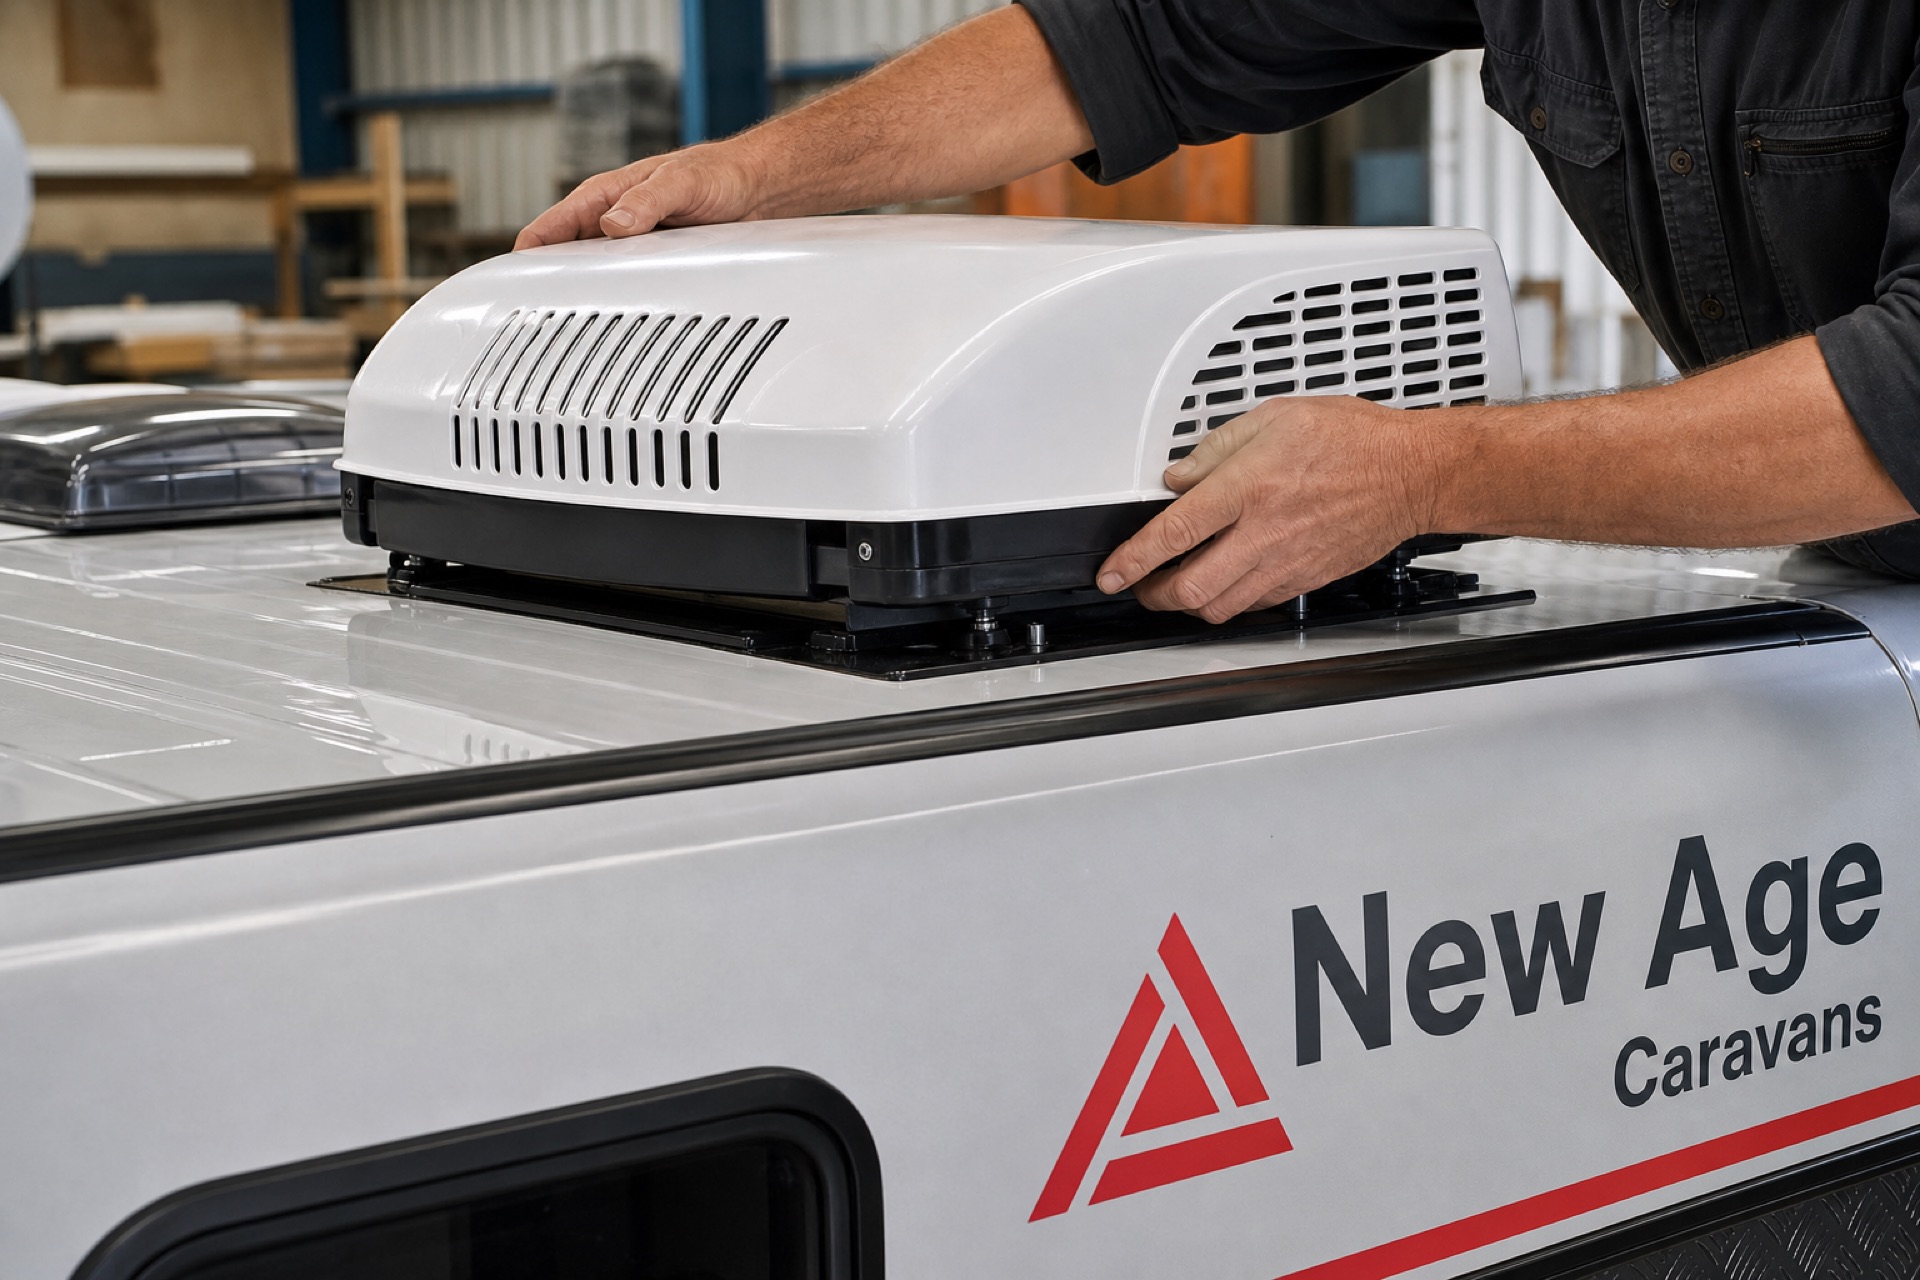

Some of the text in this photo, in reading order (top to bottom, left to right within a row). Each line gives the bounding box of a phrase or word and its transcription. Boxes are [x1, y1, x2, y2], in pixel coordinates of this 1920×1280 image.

[1291, 834, 1883, 1067] New Age
[1614, 994, 1882, 1109] Caravans
